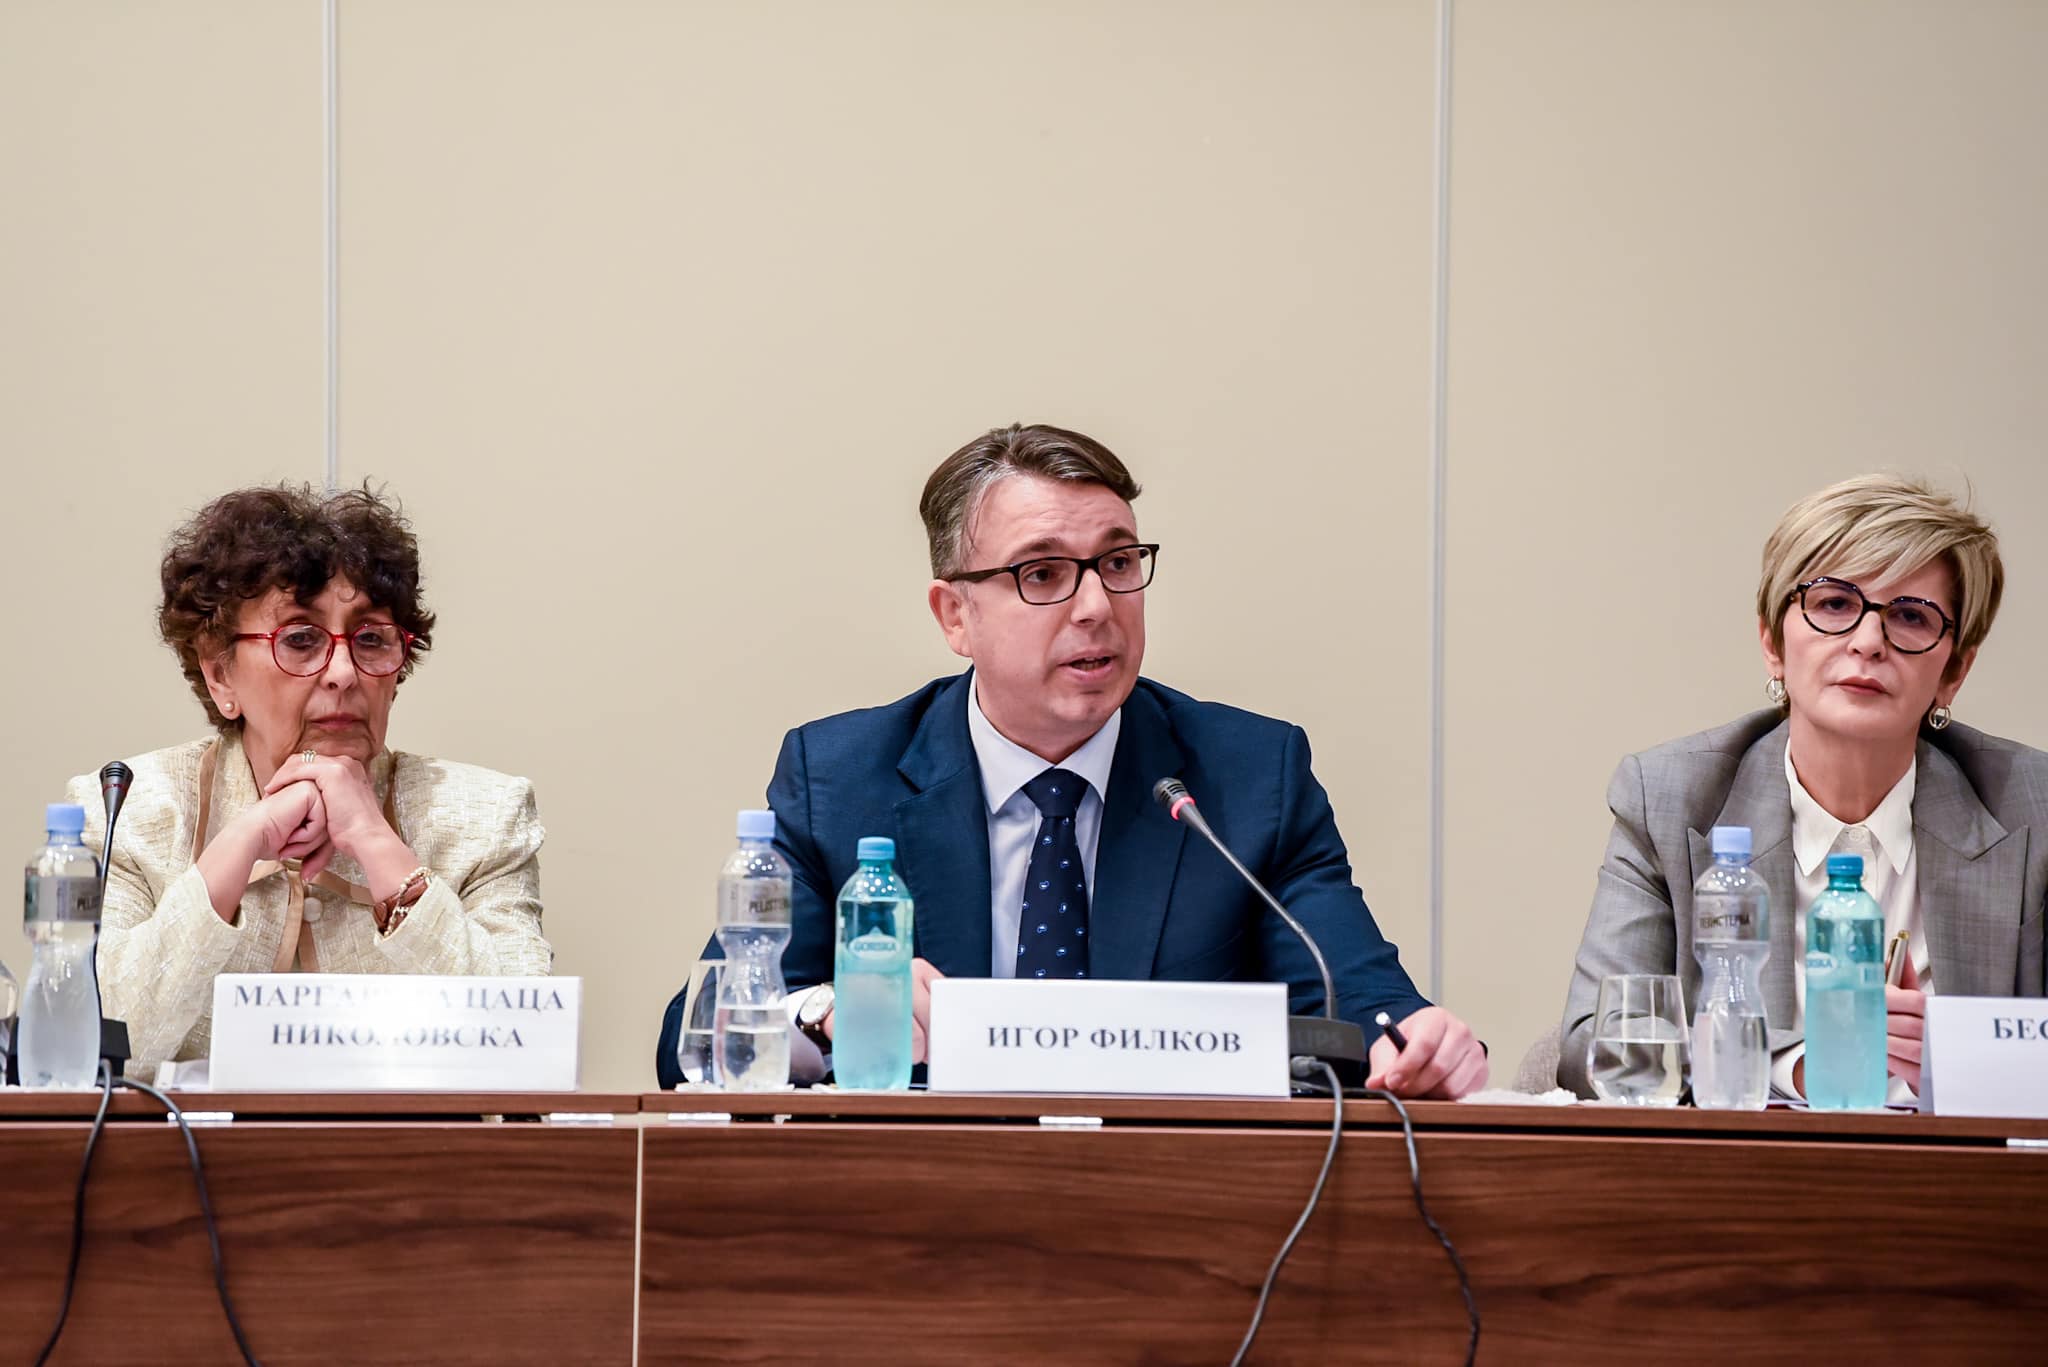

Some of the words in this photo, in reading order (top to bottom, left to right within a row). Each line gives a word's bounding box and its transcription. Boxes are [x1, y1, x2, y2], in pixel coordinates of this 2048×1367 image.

[466, 987, 566, 1014] ЦАЦА
[987, 1026, 1079, 1050] ИГОР
[1090, 1028, 1243, 1054] ФИЛКОВ
